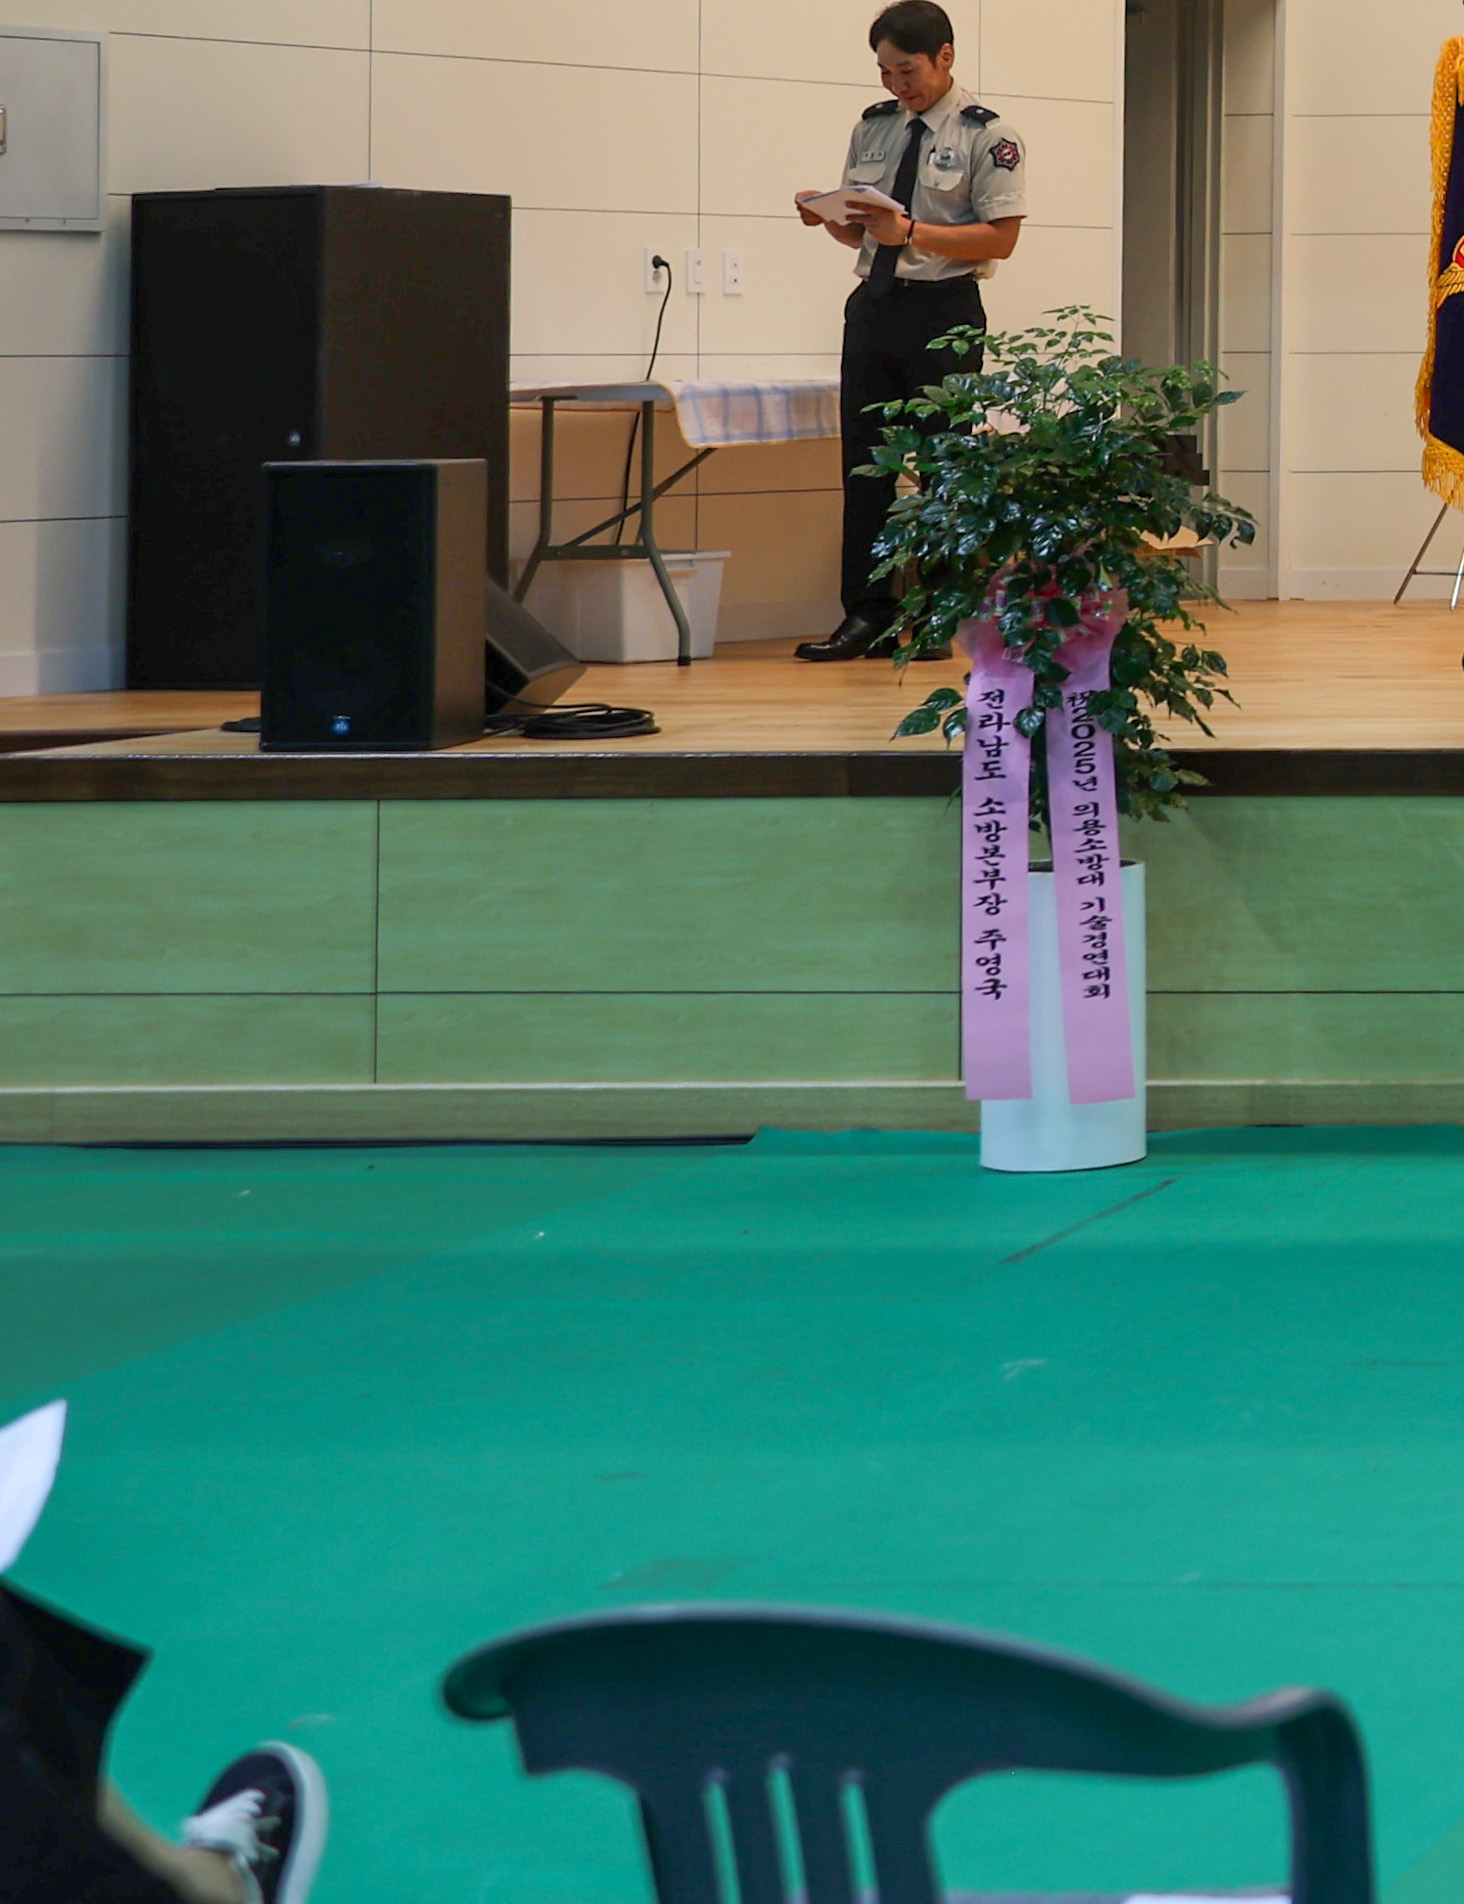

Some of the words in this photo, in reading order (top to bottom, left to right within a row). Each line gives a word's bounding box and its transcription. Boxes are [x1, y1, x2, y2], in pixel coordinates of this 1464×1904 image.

[974, 688, 1011, 782] 전라남도
[973, 797, 1008, 916] 소방본부장
[1072, 801, 1110, 887] 의용소방대
[974, 928, 1008, 1000] 주영국
[1079, 896, 1112, 999] 기술경연대회
